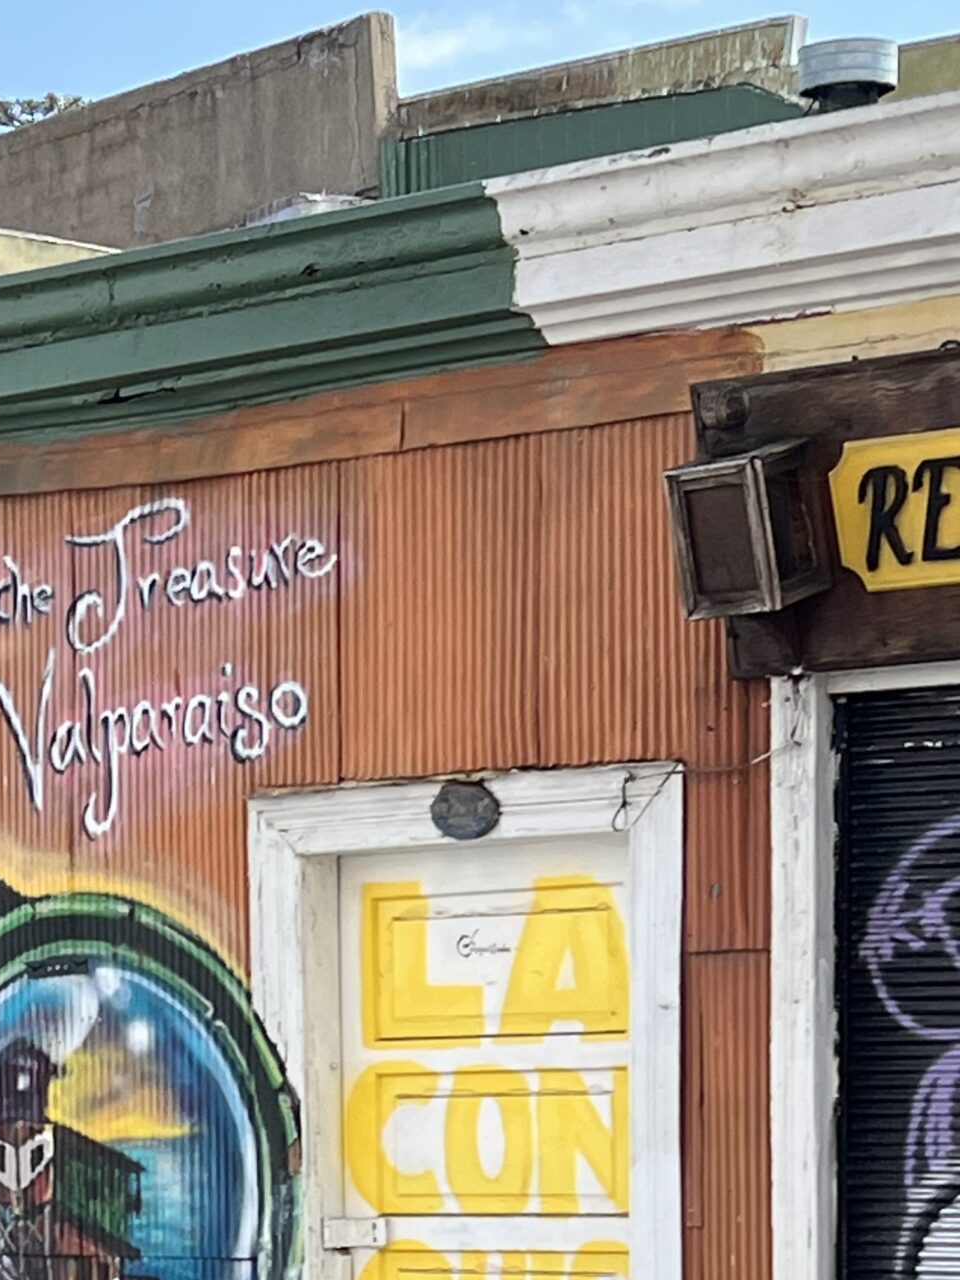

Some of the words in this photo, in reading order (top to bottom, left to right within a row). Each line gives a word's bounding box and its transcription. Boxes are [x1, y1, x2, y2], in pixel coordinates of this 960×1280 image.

[64, 497, 338, 655] Treasure
[360, 873, 629, 1049] LA
[346, 1060, 630, 1220] CON
